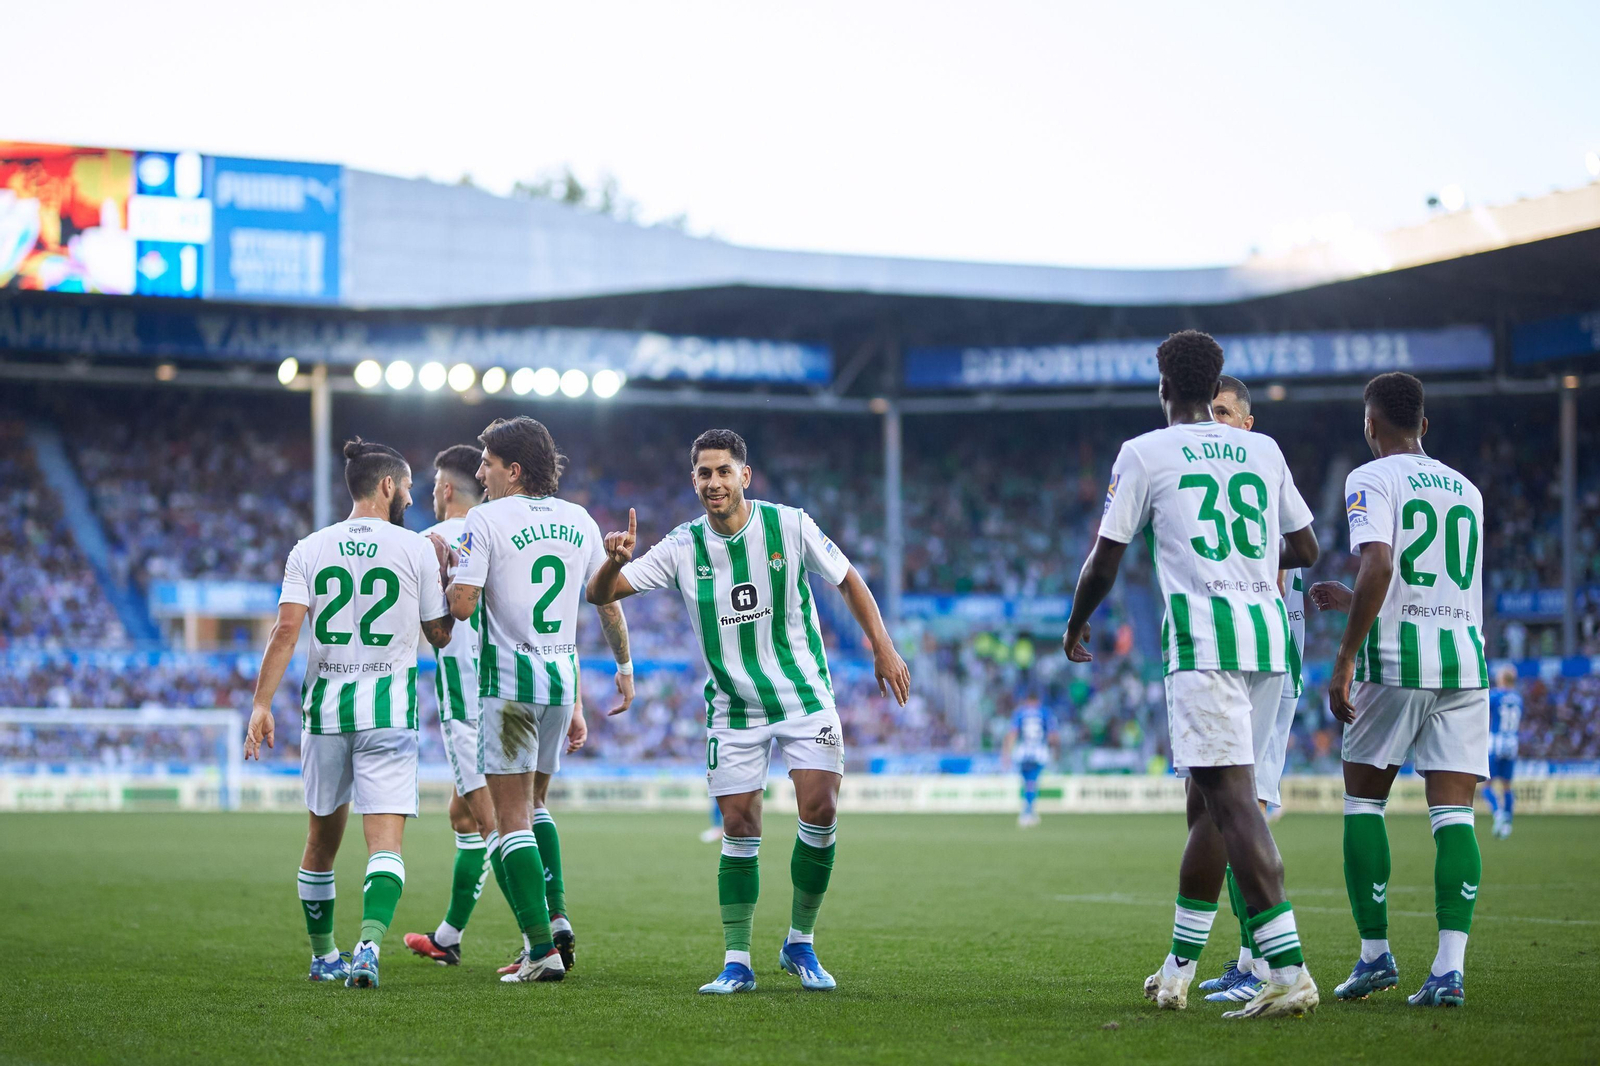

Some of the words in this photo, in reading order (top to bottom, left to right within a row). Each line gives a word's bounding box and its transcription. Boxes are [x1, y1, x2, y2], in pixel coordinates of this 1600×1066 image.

[1334, 333, 1413, 372] 1921
[1182, 442, 1247, 463] A.DIAO
[1407, 472, 1463, 496] ABNER
[1178, 472, 1268, 562] 38
[339, 541, 378, 558] ISCO
[1400, 498, 1479, 591] 20
[315, 565, 400, 646] 22
[531, 555, 566, 635] 2
[720, 608, 771, 626] finetwork
[1401, 605, 1452, 618] FOREVER
[318, 662, 360, 674] FOREVER
[361, 662, 393, 673] GREEN
